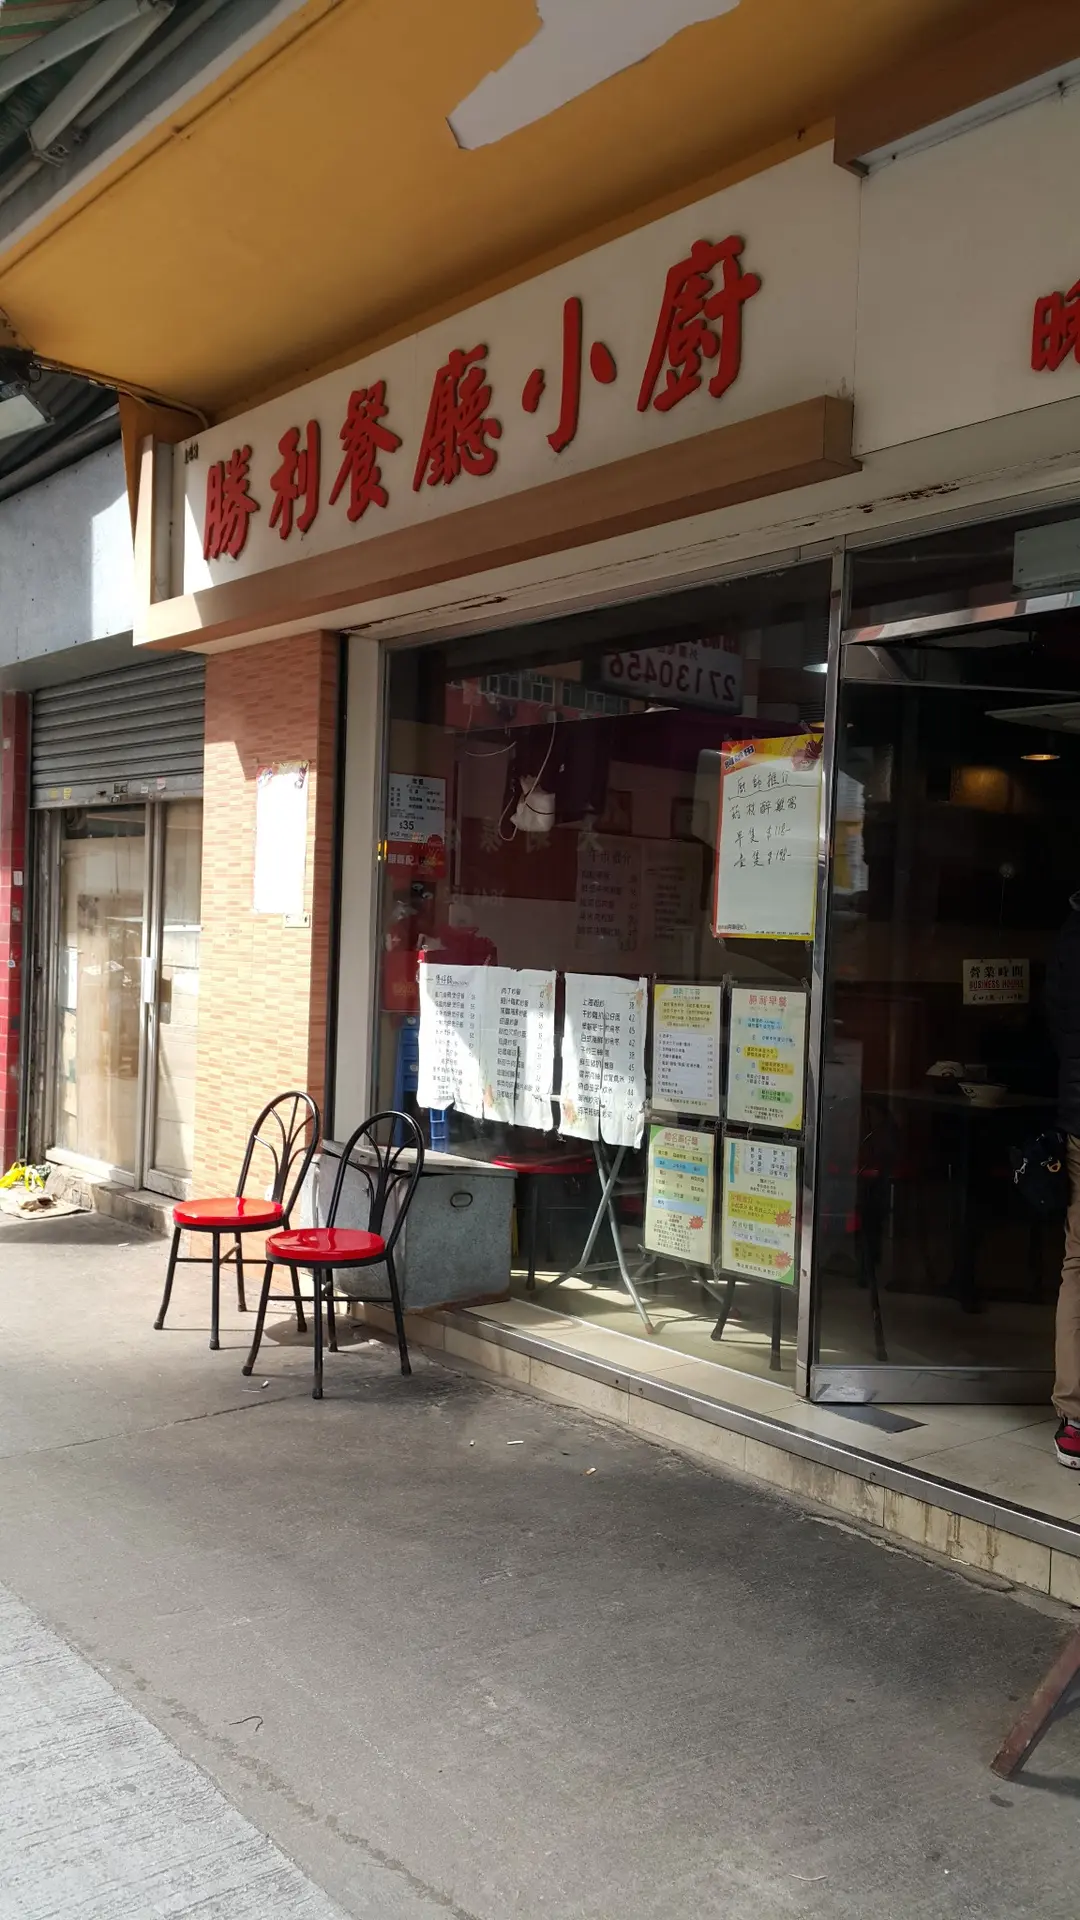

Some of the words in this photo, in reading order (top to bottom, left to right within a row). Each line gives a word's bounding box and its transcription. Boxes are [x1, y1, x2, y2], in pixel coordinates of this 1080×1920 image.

[203, 234, 762, 561] 勝利餐廳小廚
[399, 820, 414, 830] $35
